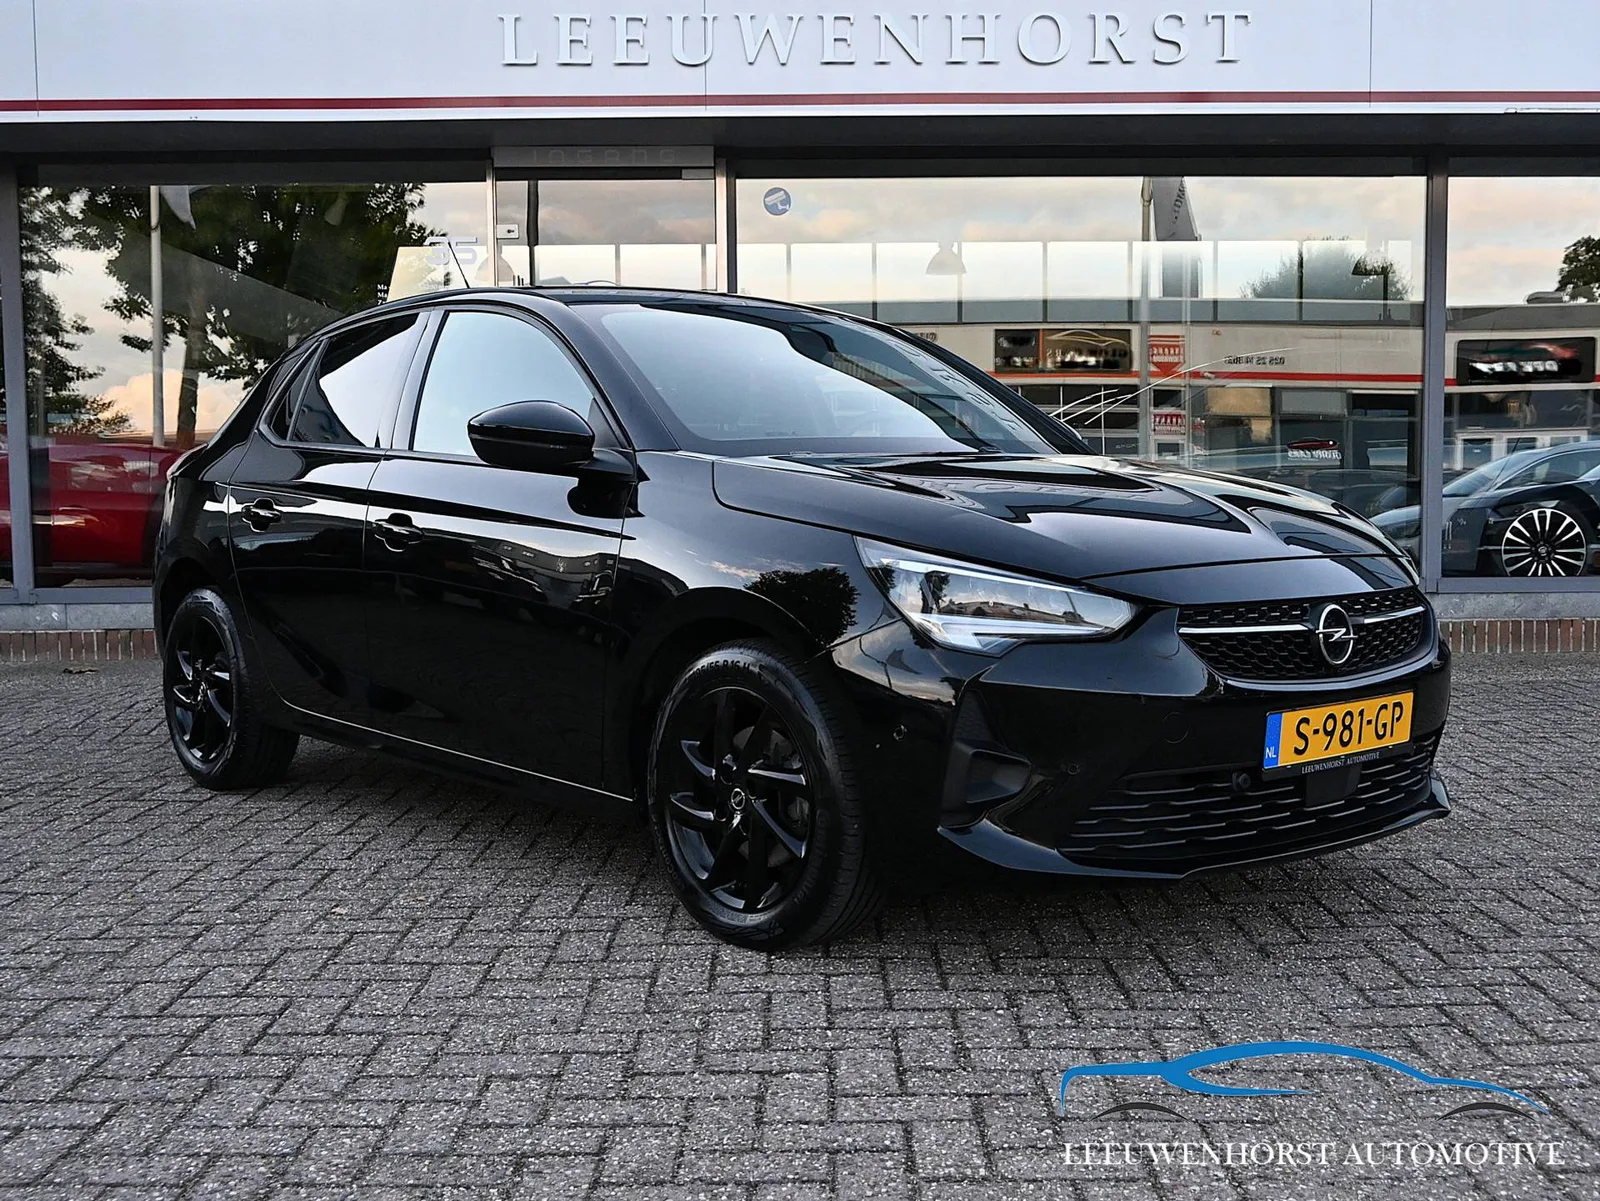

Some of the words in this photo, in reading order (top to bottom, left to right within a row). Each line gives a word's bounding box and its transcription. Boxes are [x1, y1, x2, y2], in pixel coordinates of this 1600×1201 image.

[499, 10, 1253, 67] LEEUWENHORST
[1293, 701, 1403, 756] S-981-GP
[1265, 747, 1277, 758] NL
[1301, 758, 1345, 774] LEEUWENHORST
[1347, 751, 1380, 765] AUTOMOTIVE
